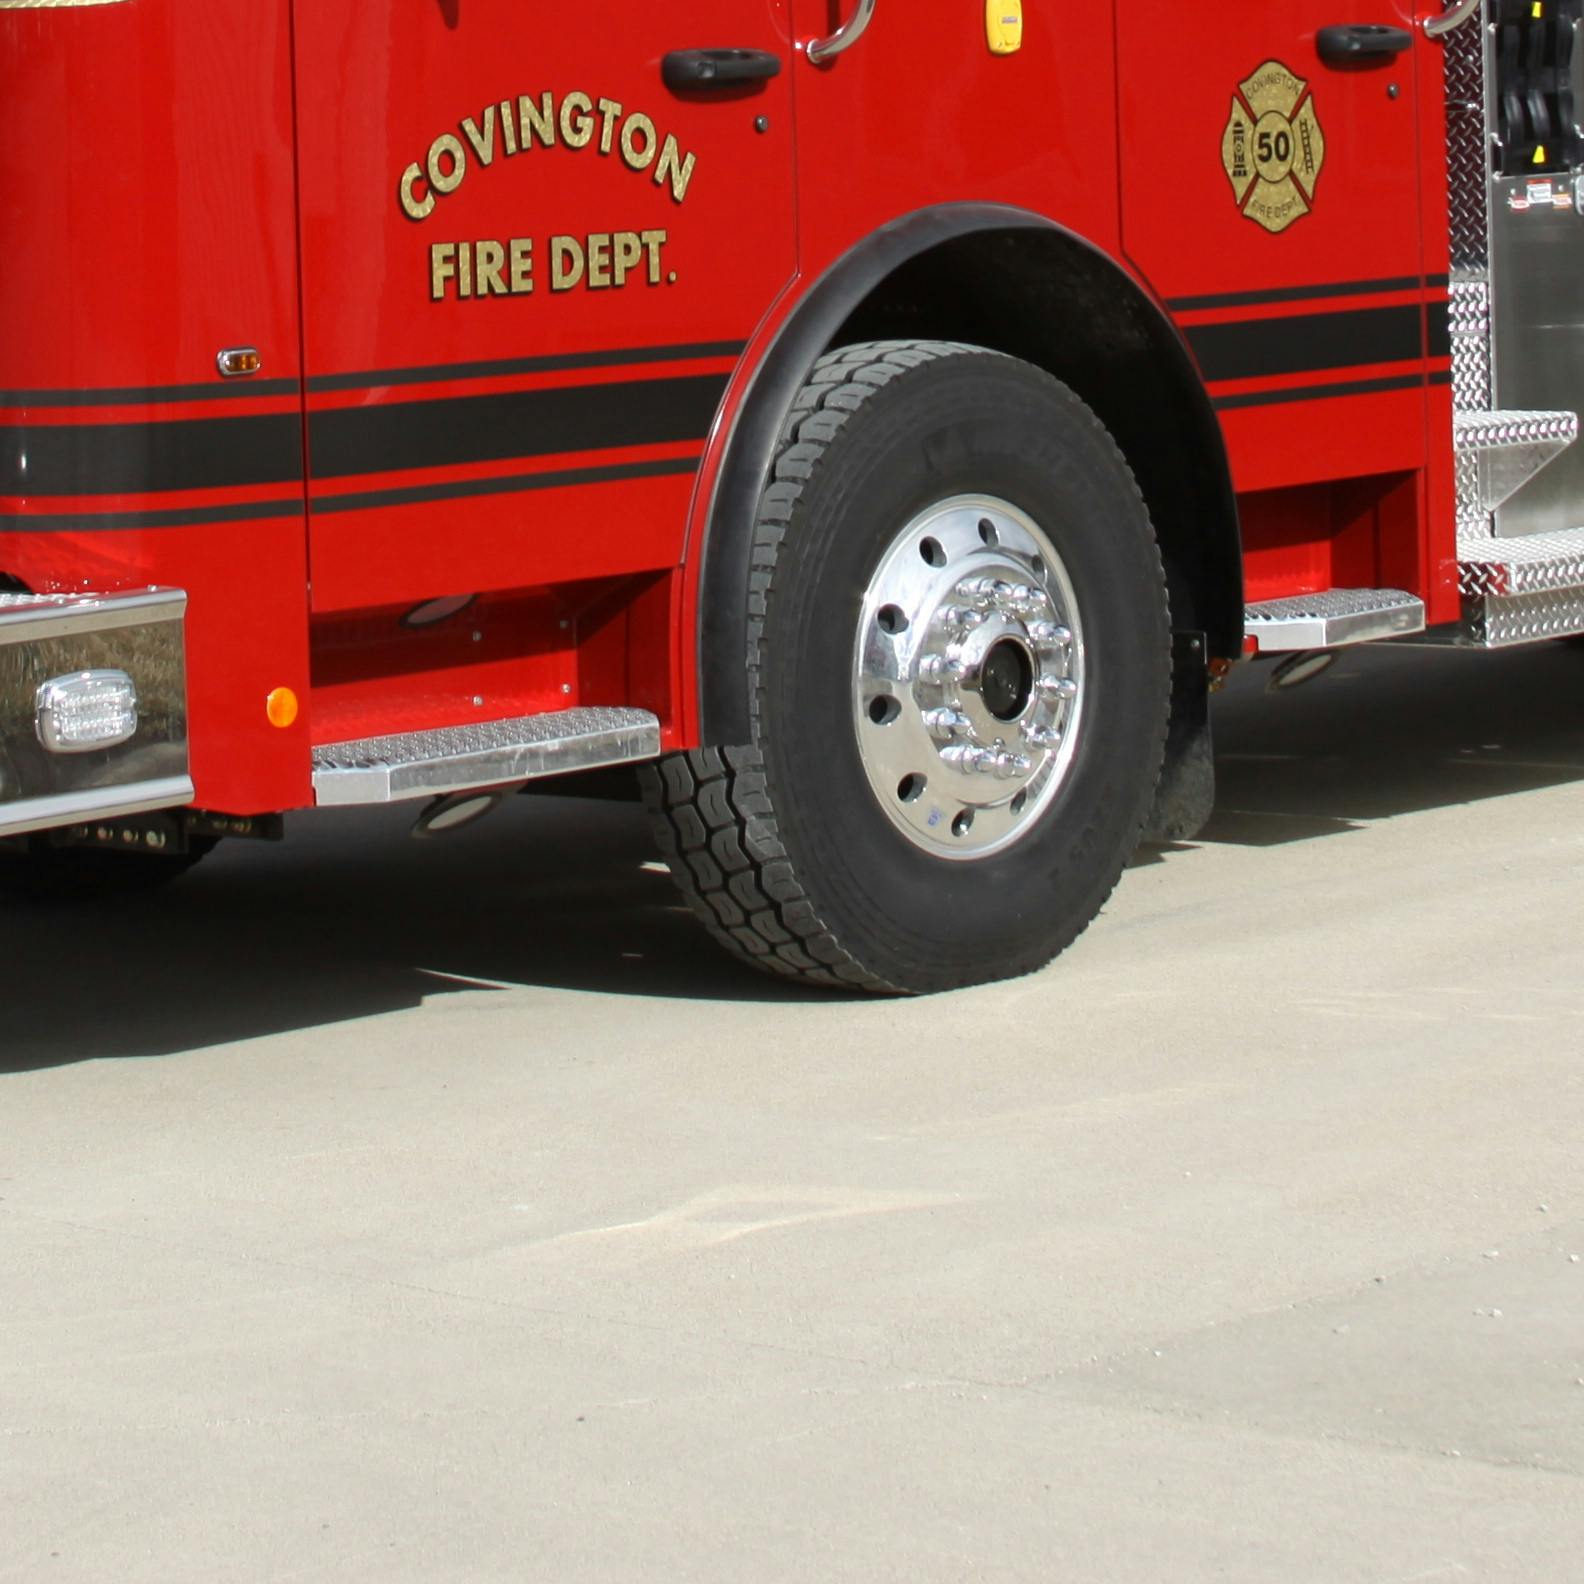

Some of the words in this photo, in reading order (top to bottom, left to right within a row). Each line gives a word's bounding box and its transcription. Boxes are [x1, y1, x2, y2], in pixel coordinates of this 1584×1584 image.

[1246, 72, 1299, 100] COVINGTON
[400, 91, 696, 220] COVINGTON
[1257, 131, 1290, 163] 50
[430, 238, 535, 301] FIRE
[550, 229, 678, 293] DEPT.
